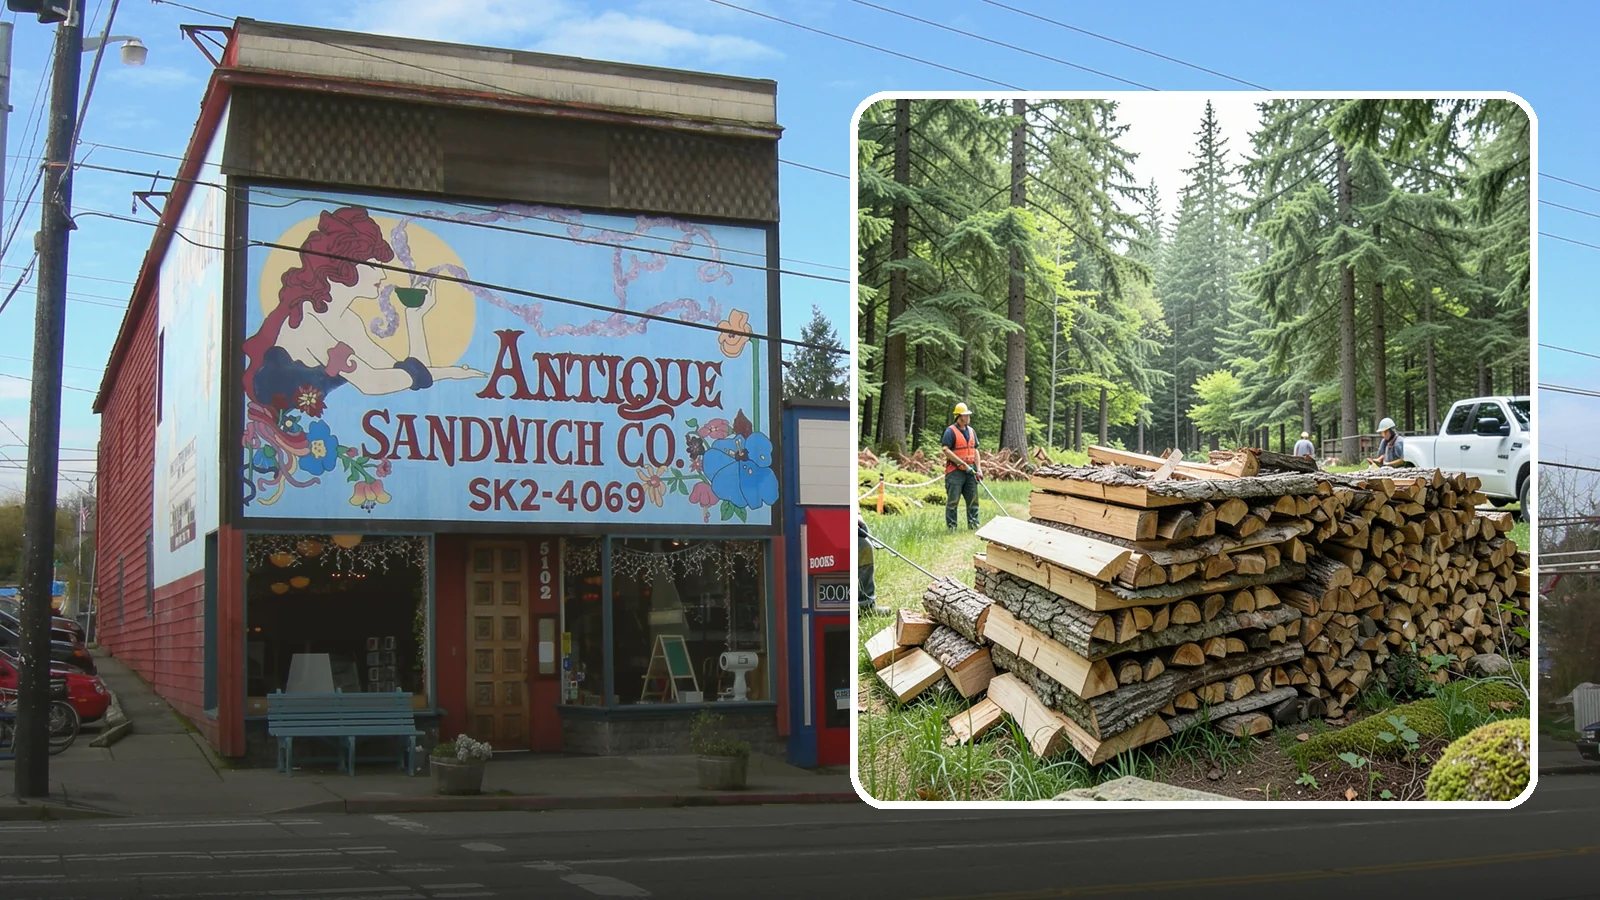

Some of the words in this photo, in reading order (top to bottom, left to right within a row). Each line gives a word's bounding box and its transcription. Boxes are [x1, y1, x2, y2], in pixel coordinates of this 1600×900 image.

[361, 408, 604, 467] SANDWICH
[616, 421, 686, 469] CO.
[468, 477, 645, 513] SK2-4069
[539, 541, 552, 600] 5102
[809, 555, 835, 569] BOOKS
